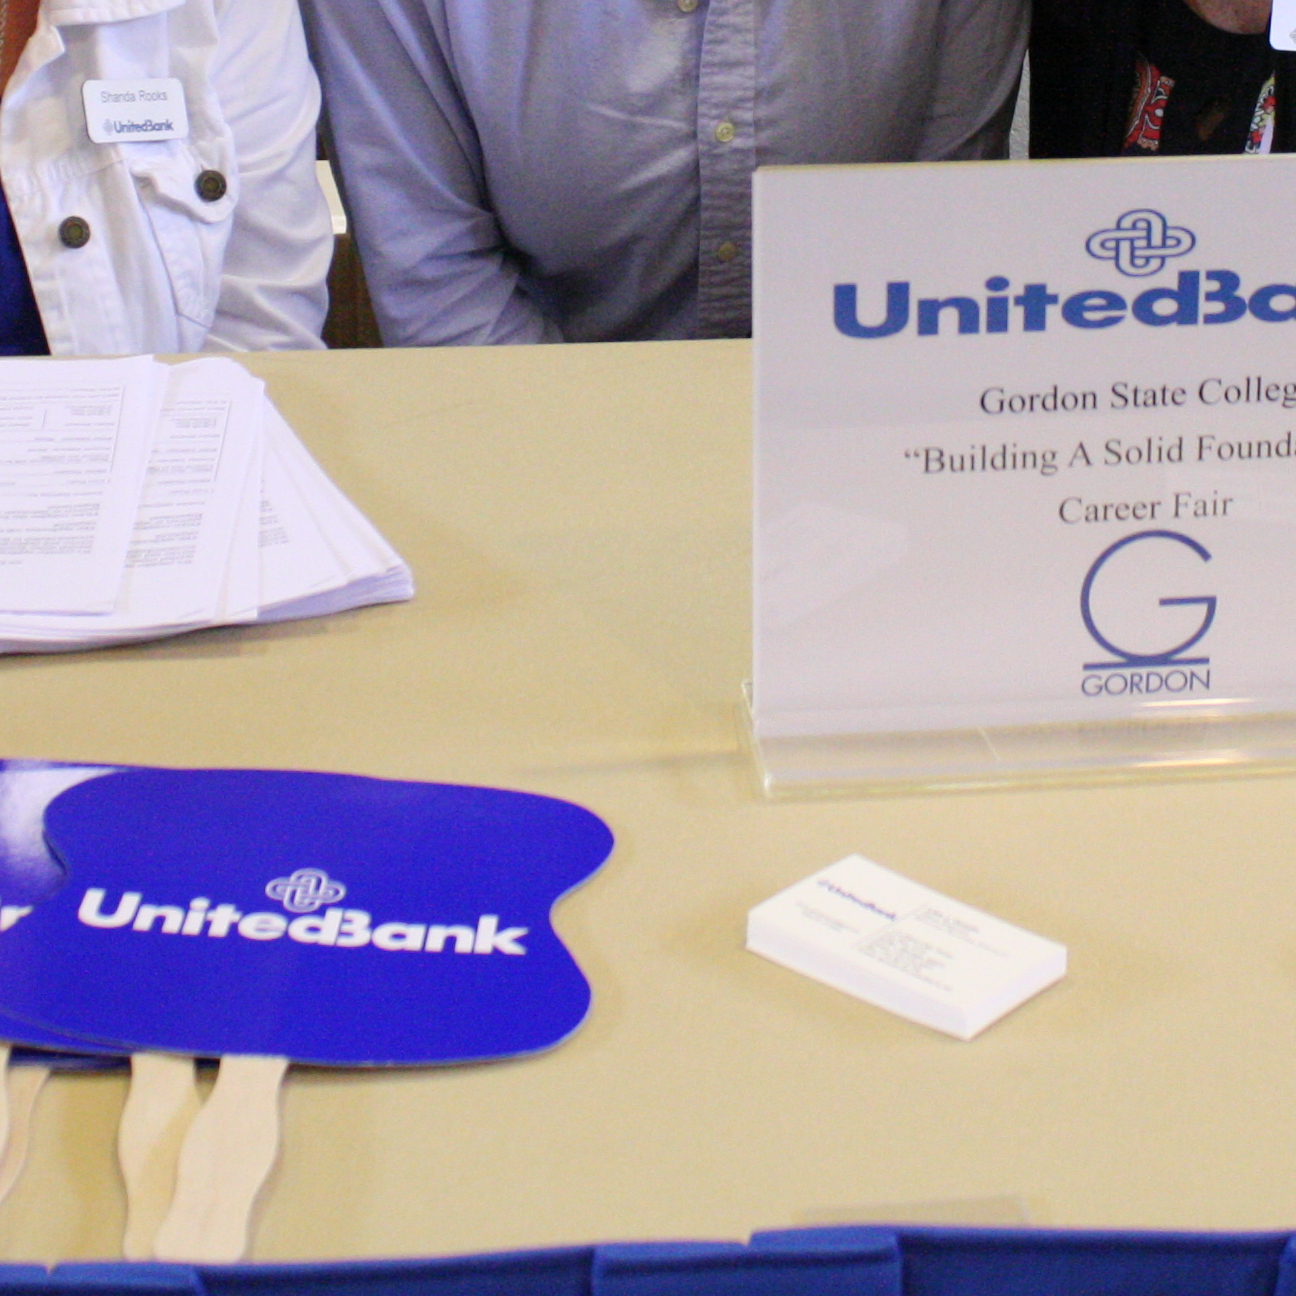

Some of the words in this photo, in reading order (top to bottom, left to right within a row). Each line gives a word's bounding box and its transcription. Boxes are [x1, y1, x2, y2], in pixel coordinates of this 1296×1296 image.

[113, 118, 174, 134] UnitedBank
[979, 384, 1099, 415] Gordon
[1109, 380, 1188, 410] State
[1067, 439, 1094, 468] A
[1103, 434, 1185, 467] Solid
[1058, 496, 1163, 524] Career
[1173, 489, 1235, 519] Fair
[1080, 668, 1211, 698] GORDON
[77, 887, 529, 956] UnitedBank
